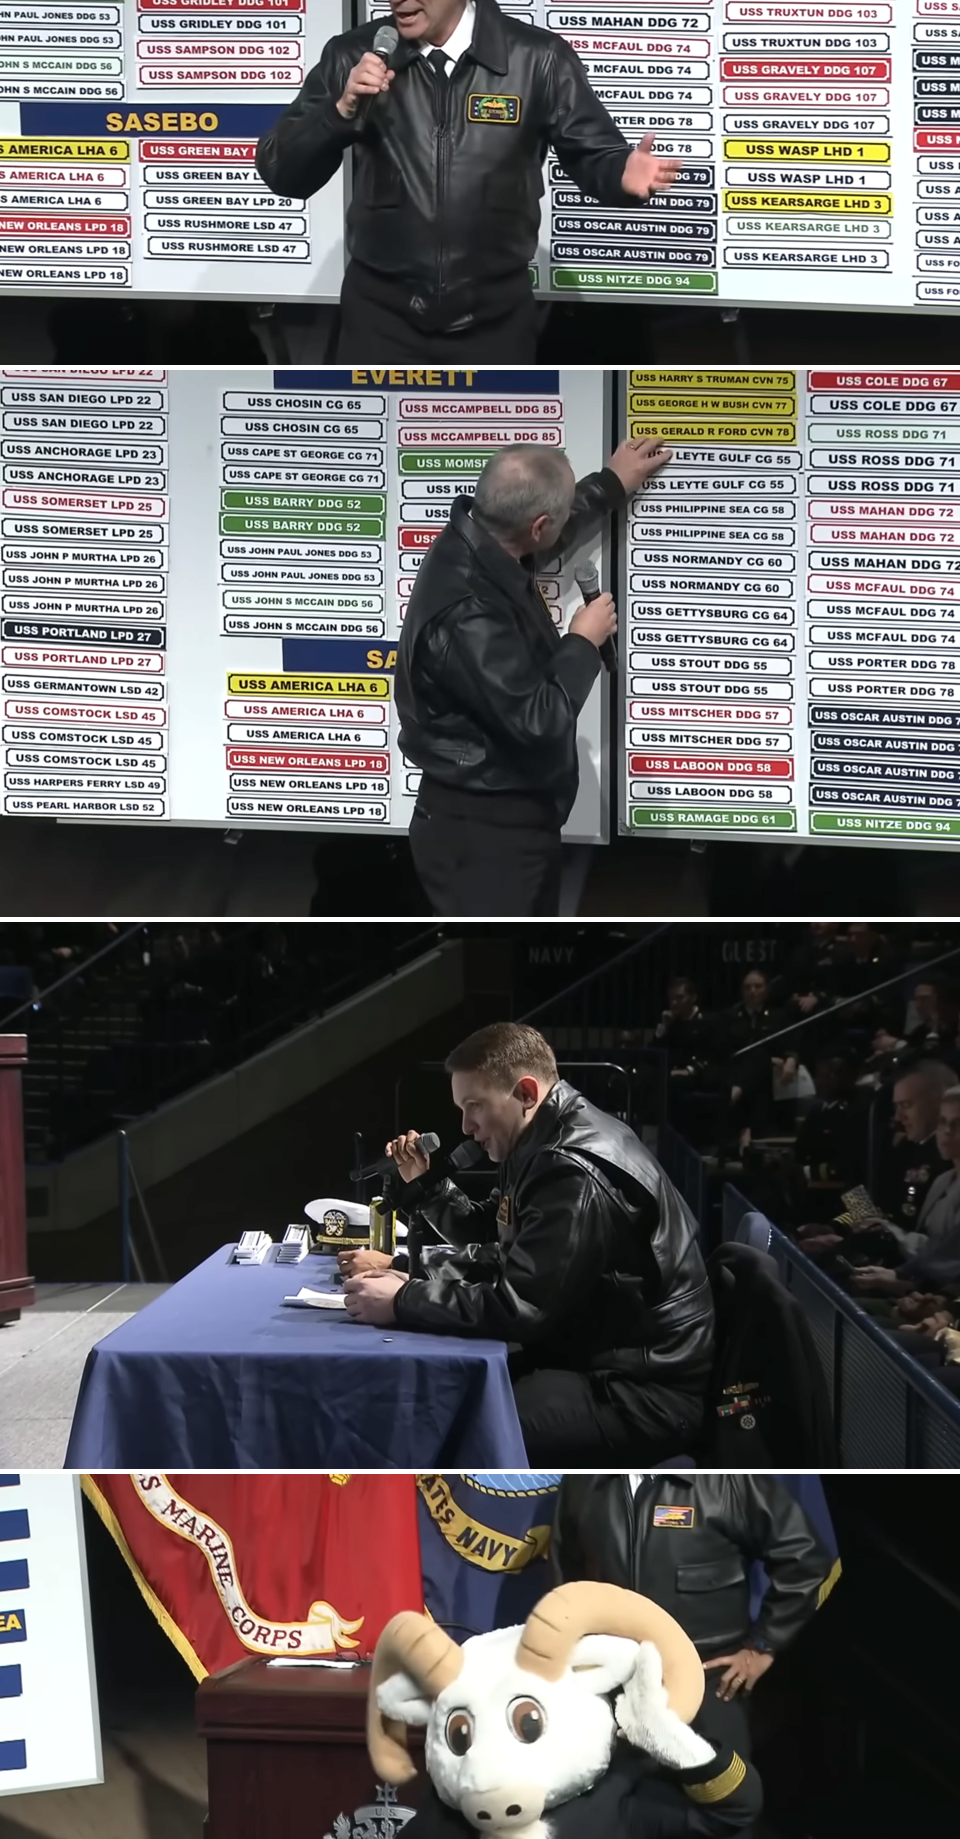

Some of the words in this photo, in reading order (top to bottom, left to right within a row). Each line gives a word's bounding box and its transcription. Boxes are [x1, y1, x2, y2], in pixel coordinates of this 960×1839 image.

[733, 65, 758, 74] USS
[762, 65, 820, 74] GRAVELY
[824, 66, 850, 75] DDG
[854, 66, 876, 75] 107
[106, 113, 218, 131] SASEBO
[746, 145, 774, 155] USS
[778, 146, 819, 155] WASP
[824, 147, 852, 156] LHD
[858, 148, 863, 156] 1
[12, 393, 35, 401] USS
[40, 394, 64, 402] SAN
[69, 394, 106, 404] DIEGO
[111, 396, 133, 404] LPD
[137, 396, 150, 404] 22
[248, 398, 271, 407] USS
[276, 399, 322, 408] CHOSIN
[326, 400, 343, 409] CG
[347, 401, 361, 410] 65
[7, 445, 30, 454] USS
[35, 446, 111, 457] ANCHORAGE
[116, 450, 138, 458] LPD
[143, 450, 156, 459] 23
[14, 495, 37, 504] USS
[42, 497, 107, 508] SOMERSET
[112, 501, 134, 510] LPD
[138, 502, 152, 511] 25
[246, 496, 269, 505] USS
[274, 498, 313, 507] BARRY
[318, 499, 342, 508] DDG
[348, 500, 360, 509] 52
[644, 554, 668, 563] USS
[673, 555, 742, 565] NORMANDY
[747, 558, 764, 566] CG
[768, 558, 782, 567] 60
[652, 658, 675, 667] USS
[680, 659, 720, 668] STOUT
[725, 661, 749, 669] DDG
[754, 662, 767, 670] 55
[239, 680, 266, 689] USS
[271, 681, 333, 691] AMERICA
[338, 683, 365, 692] LHA
[370, 683, 377, 692] 6
[646, 760, 670, 769] USS
[674, 761, 723, 771] LABOON
[728, 763, 752, 772] DDG
[757, 764, 771, 772] 58
[529, 947, 575, 962] NAVY
[457, 1529, 518, 1567] NAVY
[165, 1499, 234, 1588] MARINE
[231, 1605, 302, 1650] CORPS
